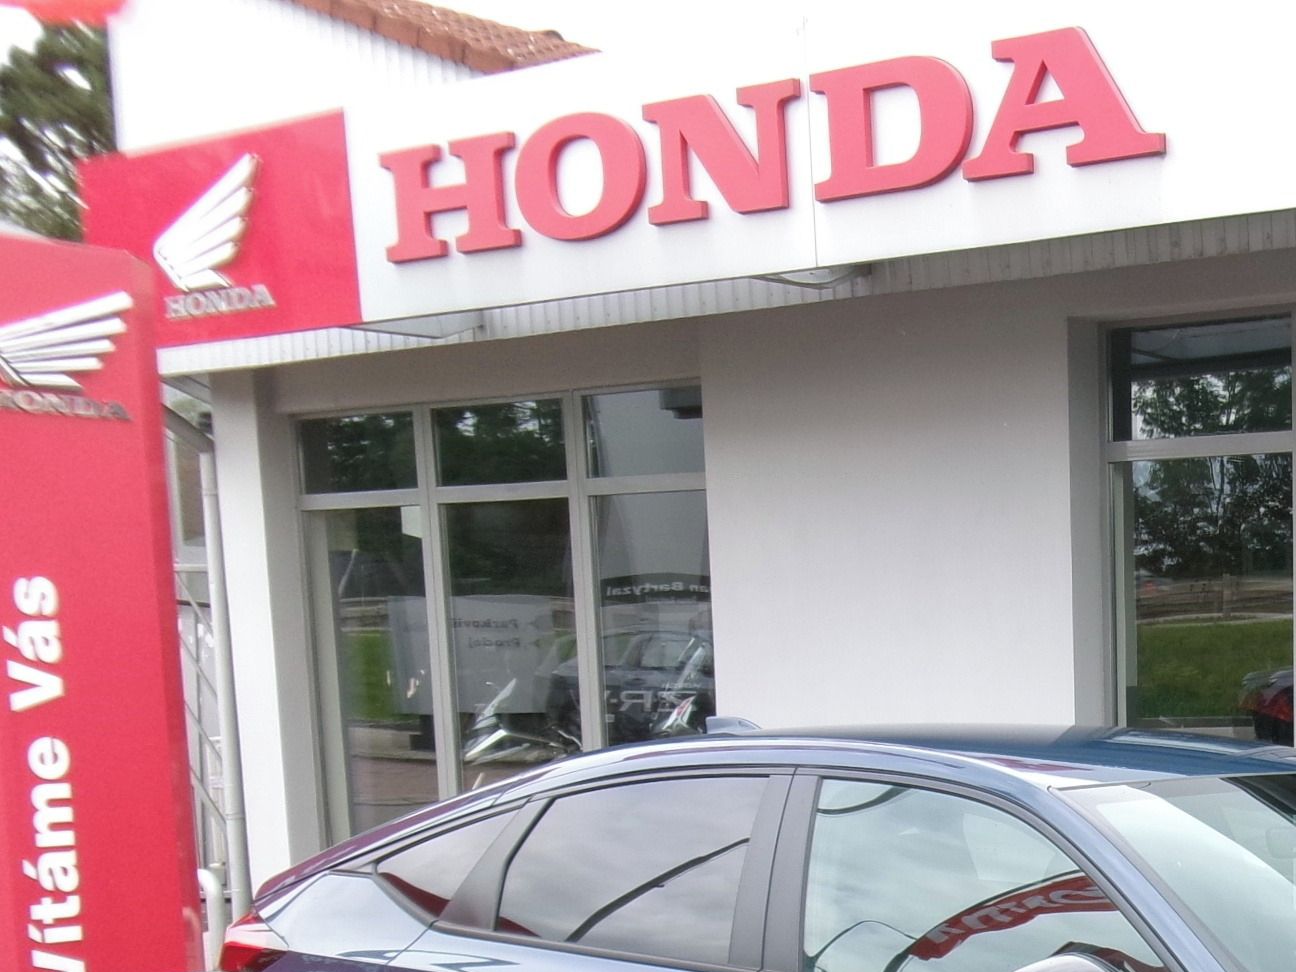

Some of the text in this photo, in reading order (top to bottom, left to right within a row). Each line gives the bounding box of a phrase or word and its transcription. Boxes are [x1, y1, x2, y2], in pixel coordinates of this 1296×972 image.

[380, 26, 1167, 263] HONDA
[164, 284, 276, 318] HONDA
[3, 576, 65, 712] Vás
